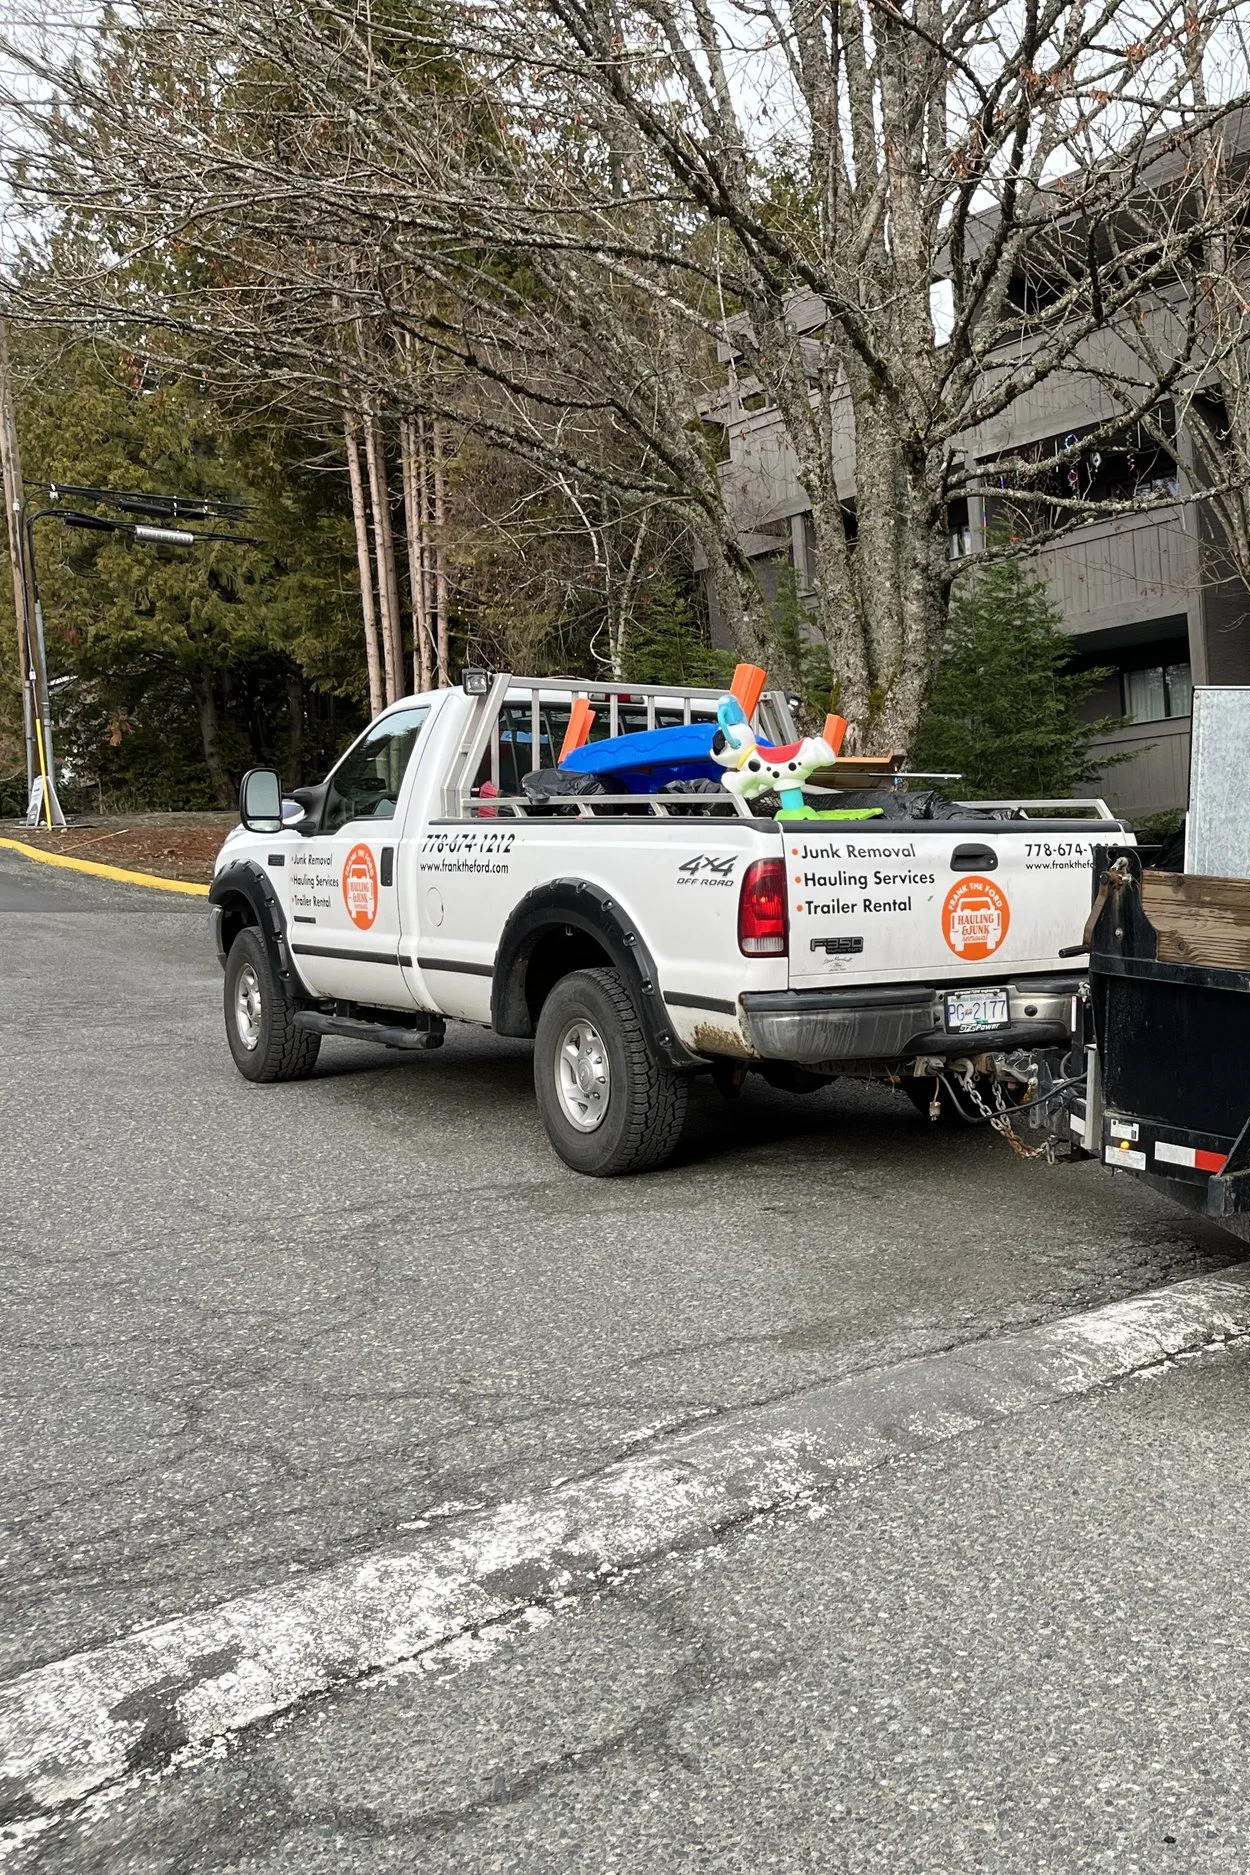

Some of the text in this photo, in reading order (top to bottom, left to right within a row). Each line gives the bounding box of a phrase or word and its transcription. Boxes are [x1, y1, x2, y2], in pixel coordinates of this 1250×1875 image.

[422, 833, 515, 853] 778-674-1212
[801, 843, 917, 859] Junk Removal
[293, 853, 306, 865] Junk
[308, 853, 333, 866] Removal
[419, 858, 509, 874] www.franktheford.com
[293, 873, 339, 889] Hauling Services
[677, 877, 734, 887] OFF ROAD
[804, 869, 936, 889] Hauling Services
[294, 894, 332, 908] Trailer Rental
[948, 882, 1003, 910] FRANK THE FORD
[805, 896, 912, 915] Trailer Rental
[957, 914, 994, 925] HAULING
[948, 1000, 1006, 1023] PG 2177
